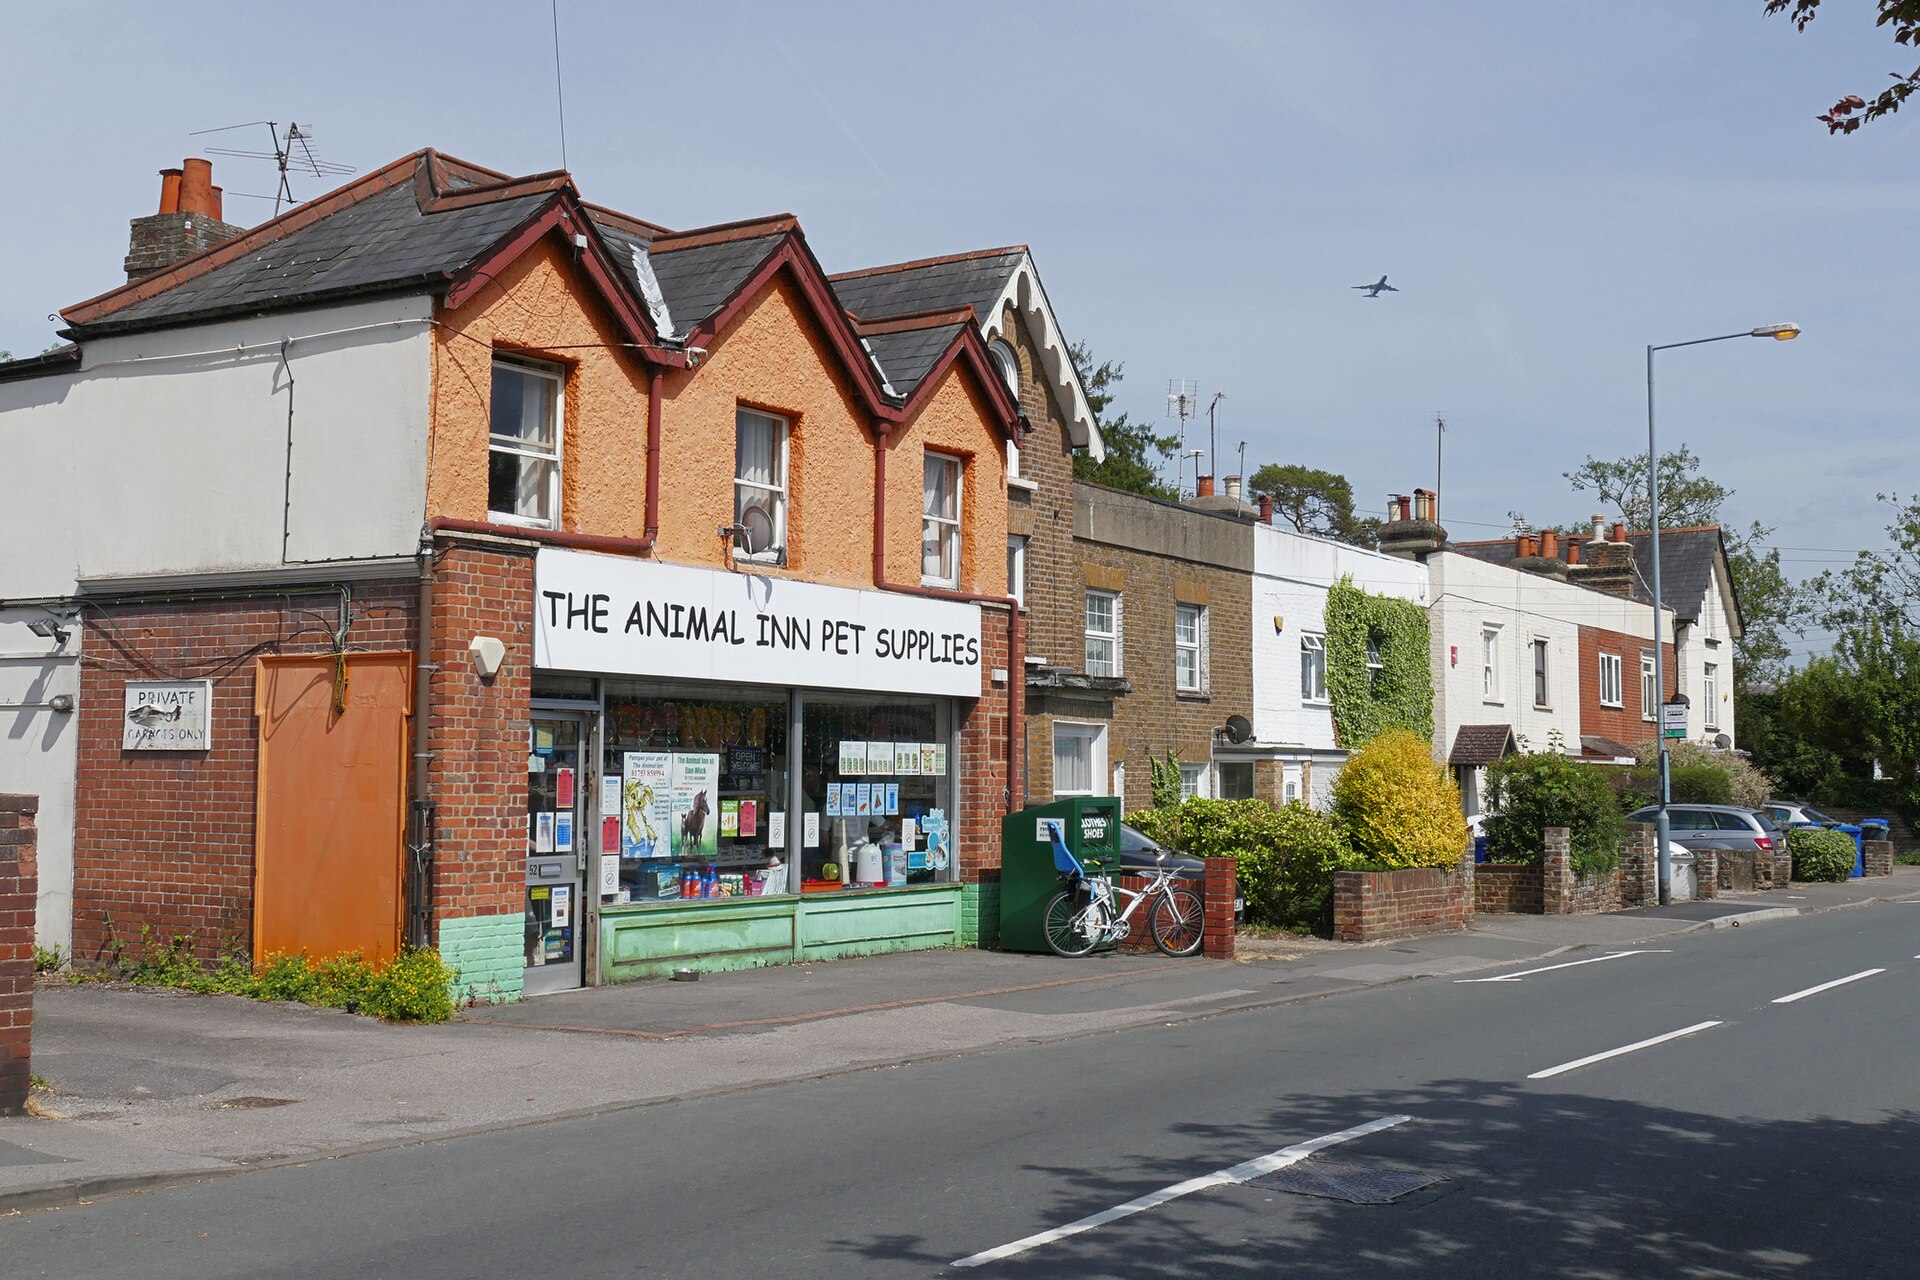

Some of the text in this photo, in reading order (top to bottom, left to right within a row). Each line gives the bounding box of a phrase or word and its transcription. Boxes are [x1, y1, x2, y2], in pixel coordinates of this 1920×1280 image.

[543, 590, 979, 666] THE ANIMAL INN PET SUPPLIES
[138, 691, 195, 705] PRIVATE
[178, 729, 205, 740] ONLY
[677, 756, 685, 764] The
[686, 756, 700, 764] Animal
[735, 751, 756, 761] OPEN
[1084, 828, 1104, 839] SHOES
[529, 864, 538, 876] 52
